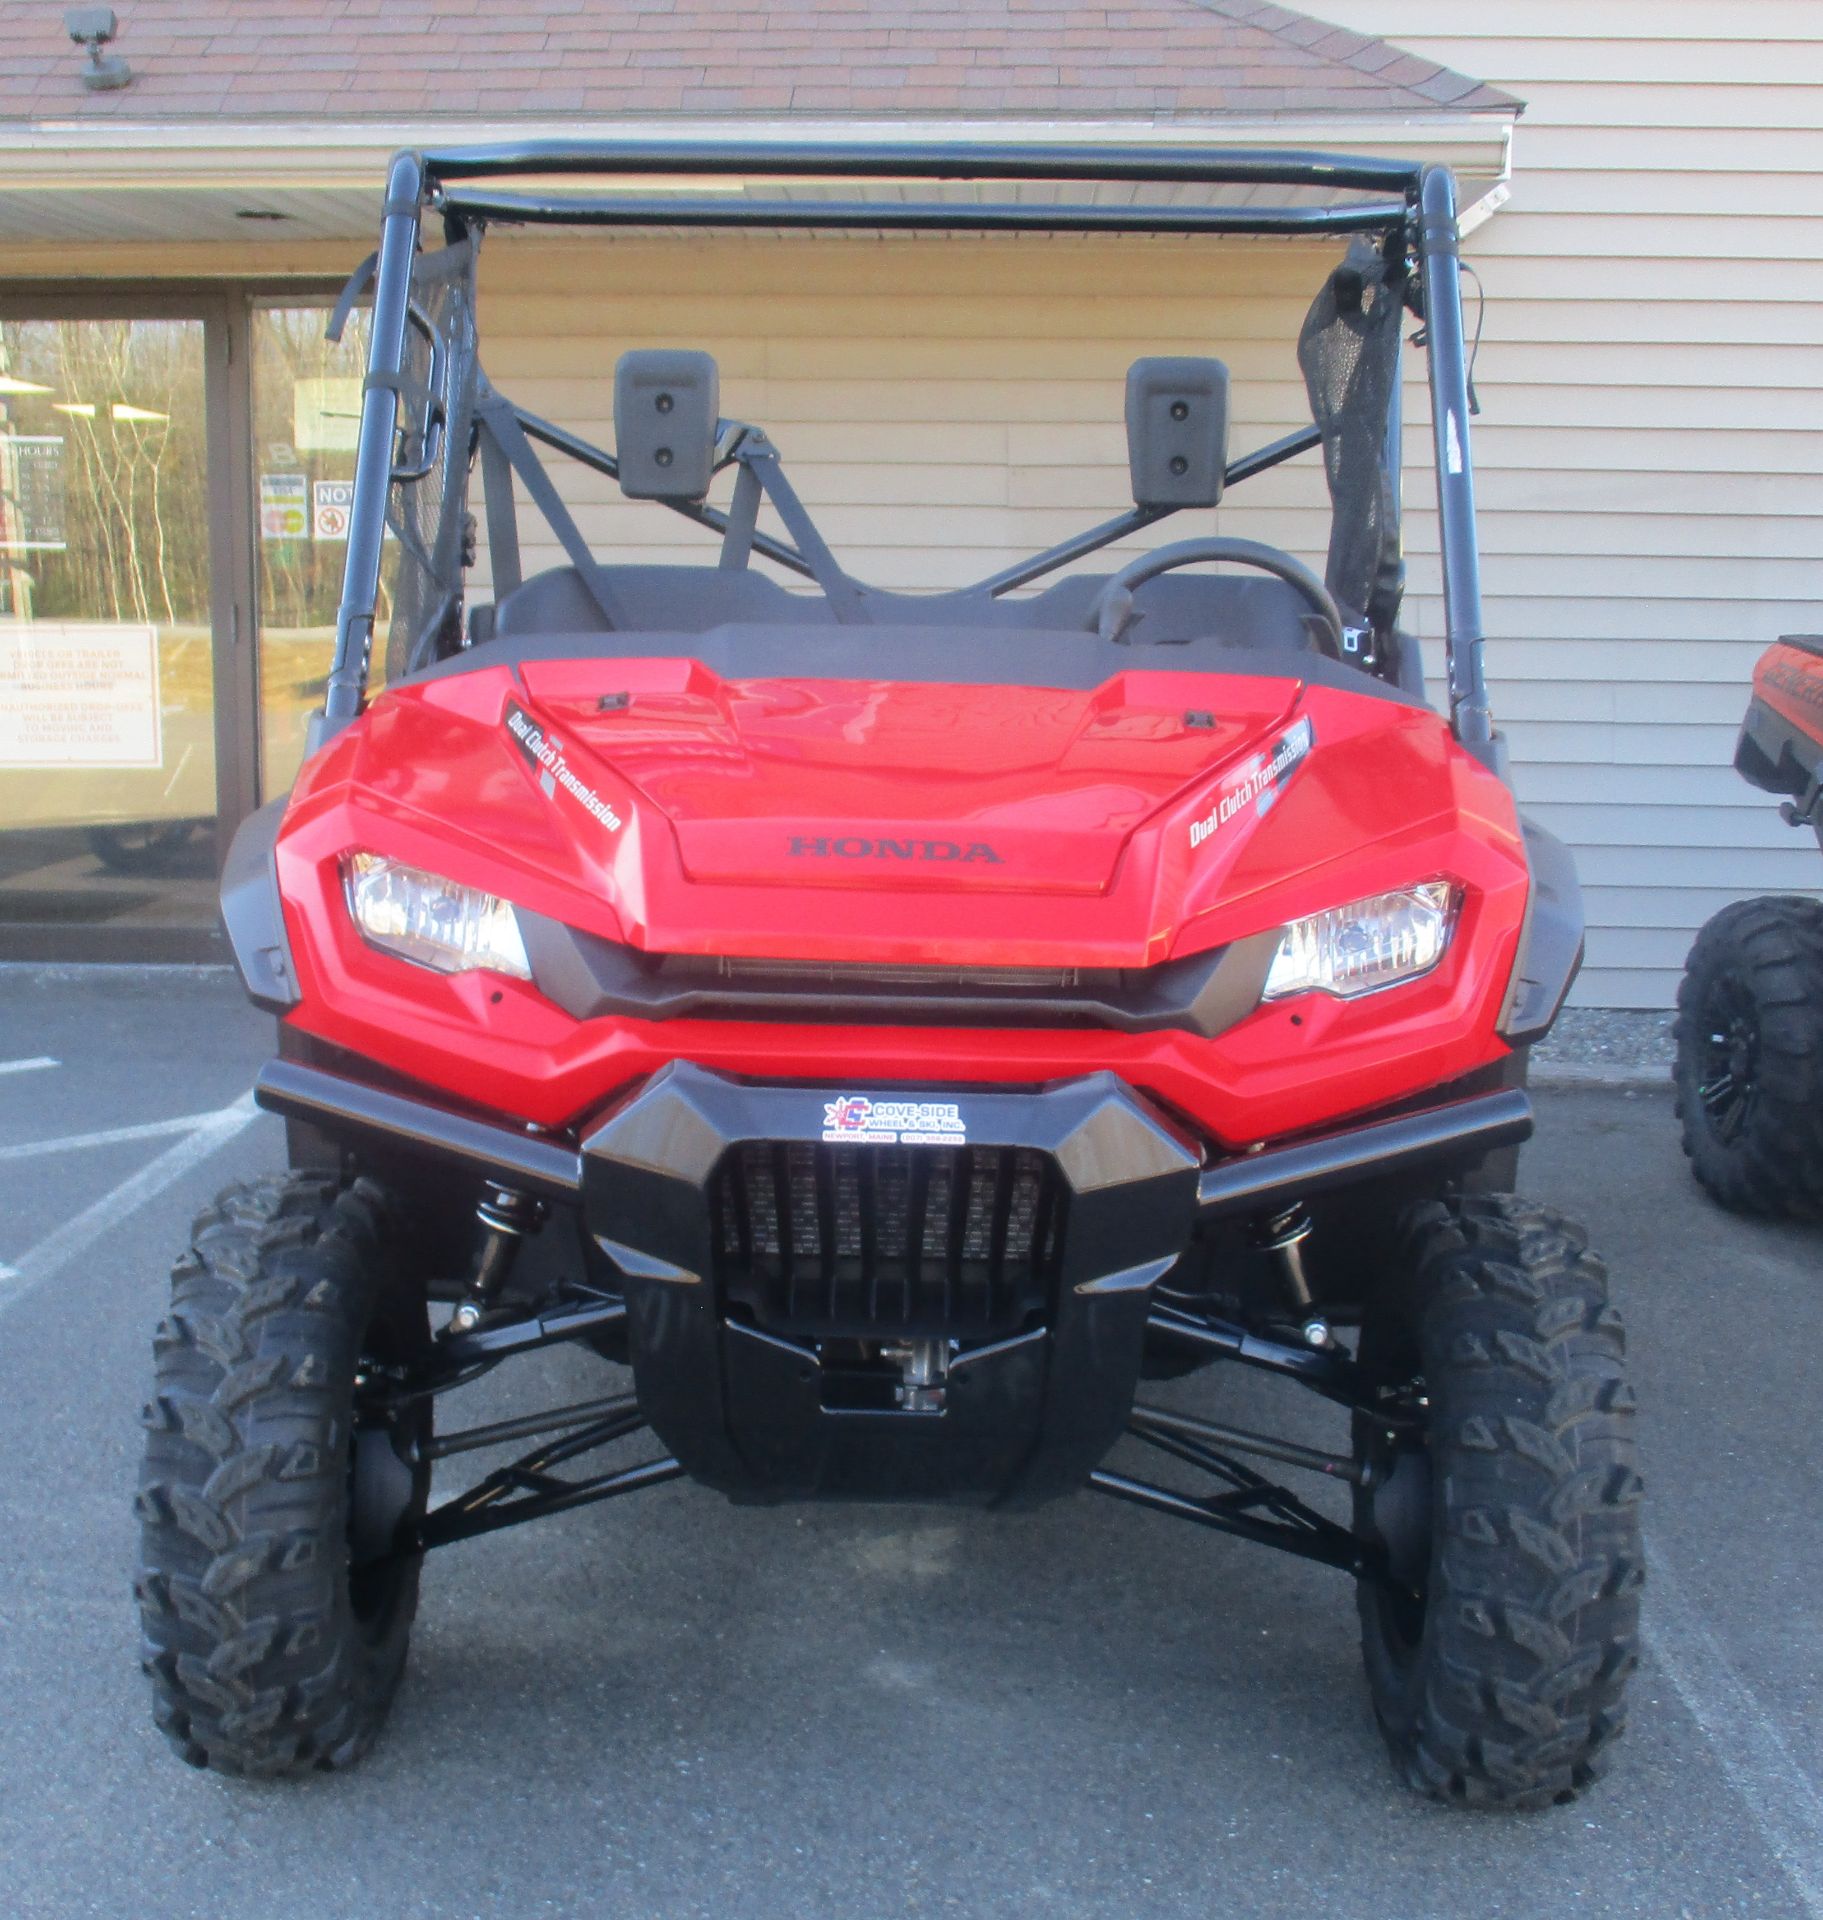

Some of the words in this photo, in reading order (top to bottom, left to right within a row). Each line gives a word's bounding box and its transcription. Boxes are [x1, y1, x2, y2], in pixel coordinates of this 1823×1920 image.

[19, 445, 59, 457] HOURS
[508, 711, 533, 740] Dual
[525, 730, 556, 767] Clutch
[551, 755, 621, 832] Transmission
[1189, 806, 1219, 849] Dual
[1220, 783, 1252, 824] Clutch
[1250, 731, 1310, 794] Transmission
[786, 837, 1006, 863] HONDA
[875, 1104, 956, 1118] COVE-SIDE
[869, 1118, 903, 1128] WHEEL
[908, 1118, 916, 1128] &
